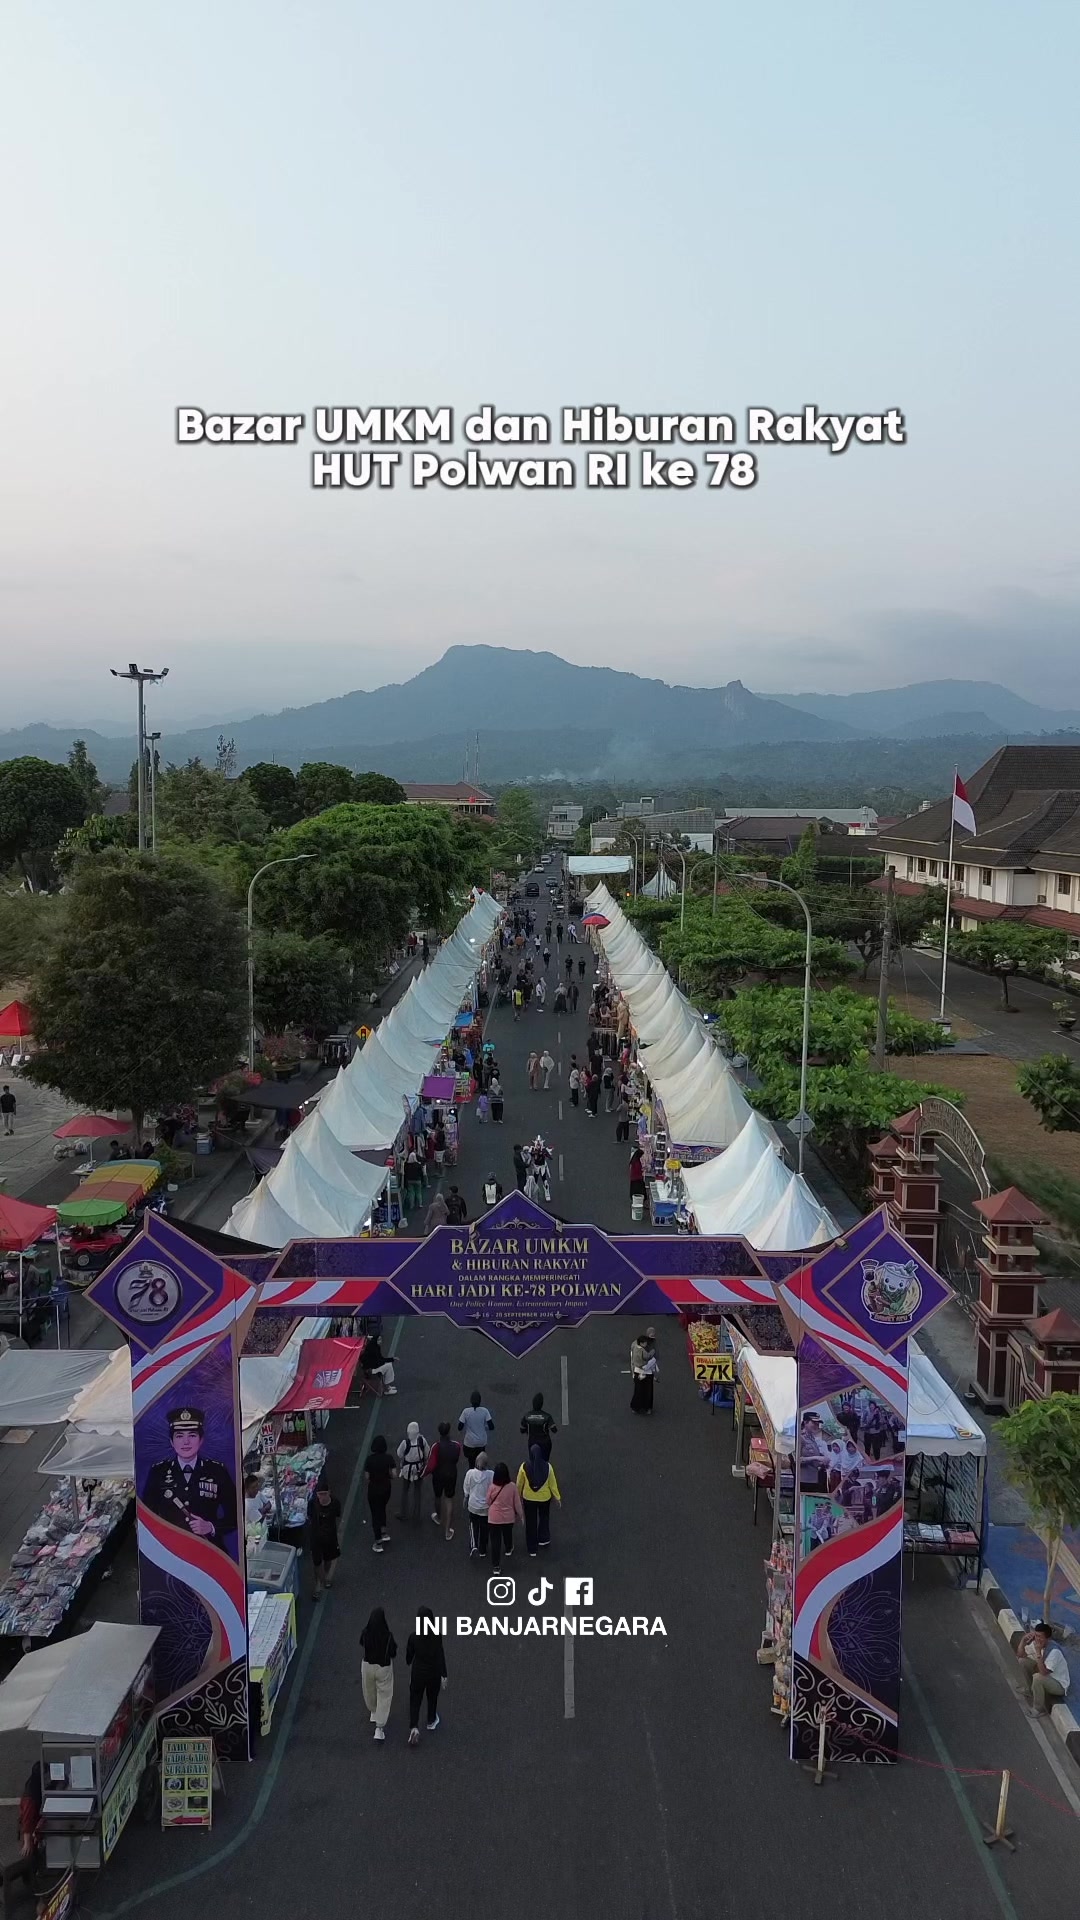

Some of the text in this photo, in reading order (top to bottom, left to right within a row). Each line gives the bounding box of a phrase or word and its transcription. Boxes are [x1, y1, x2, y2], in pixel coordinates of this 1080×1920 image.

[450, 1237, 589, 1255] BAZAR UMKM
[451, 1258, 588, 1270] & HIBURAN RAKYAT
[128, 1278, 169, 1308] 78
[411, 1283, 621, 1298] HARI JADI KE-78 POLWAN
[696, 1365, 731, 1380] 27K
